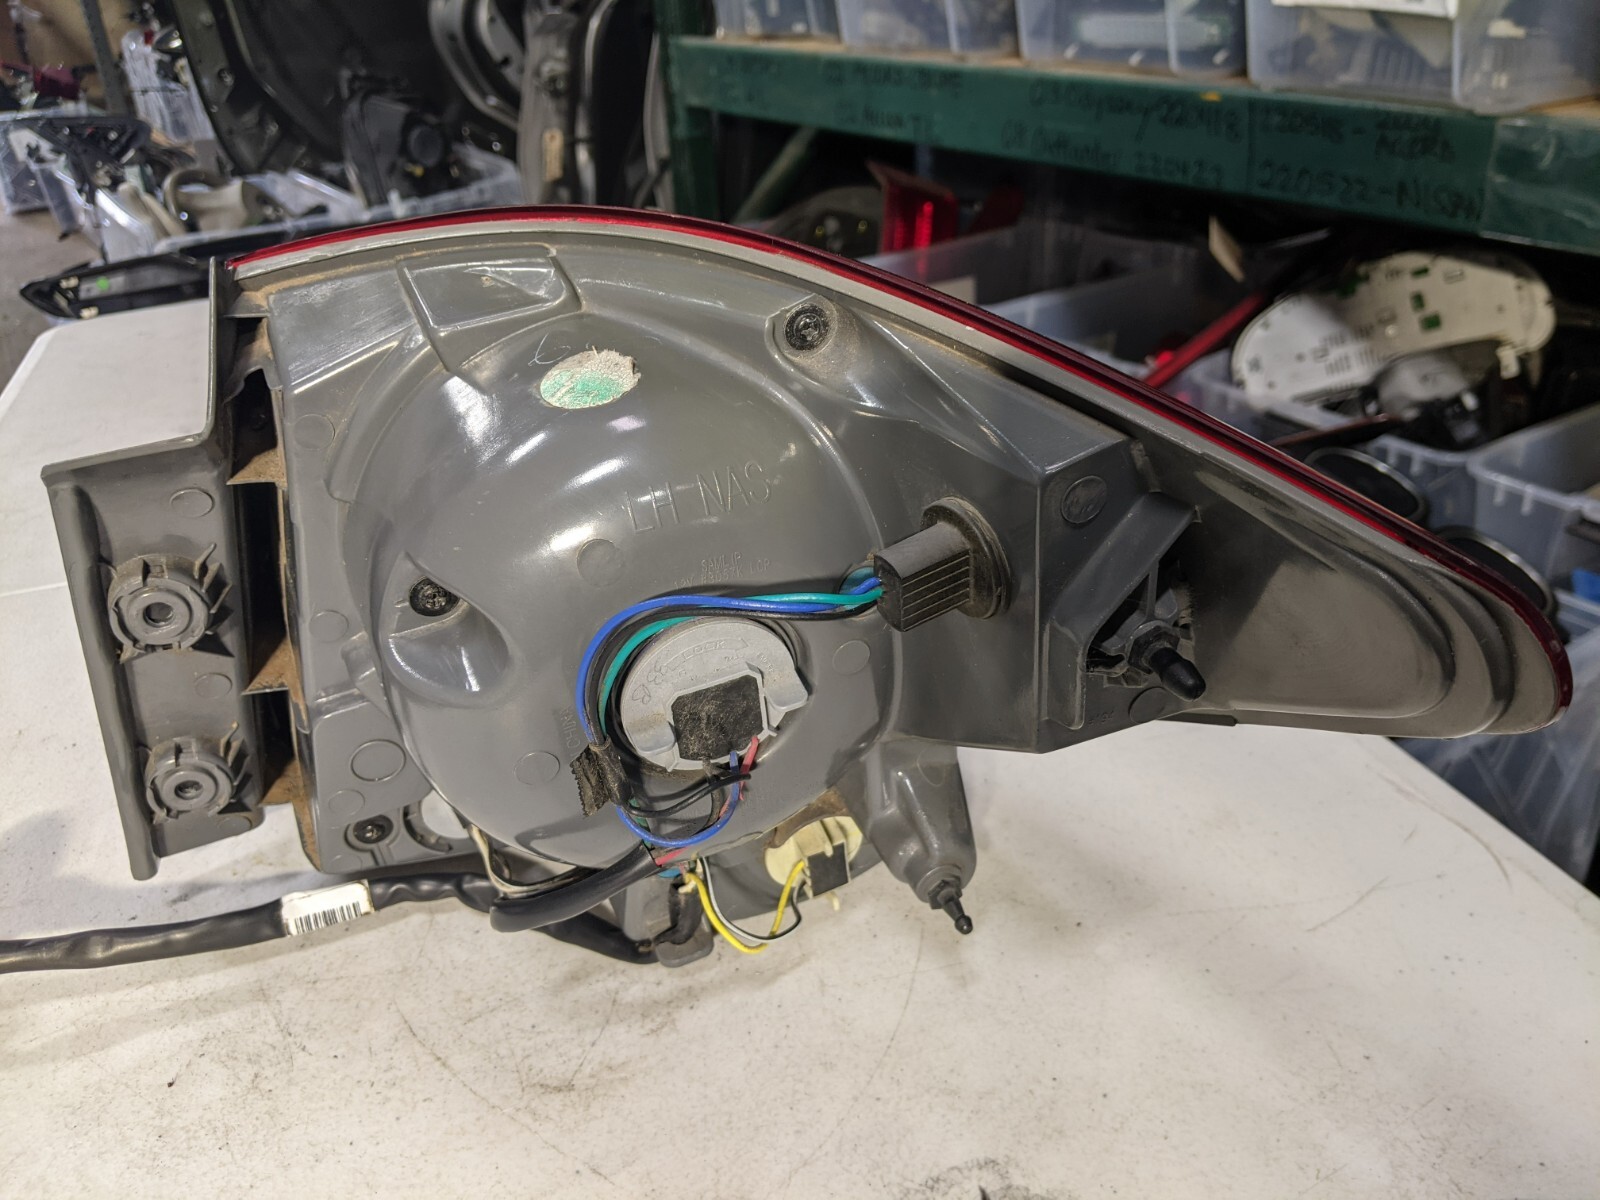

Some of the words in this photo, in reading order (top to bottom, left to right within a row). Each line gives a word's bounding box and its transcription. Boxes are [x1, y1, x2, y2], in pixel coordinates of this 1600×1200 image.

[624, 481, 680, 534] LH
[696, 460, 772, 516] NAS
[683, 640, 727, 660] LOCK
